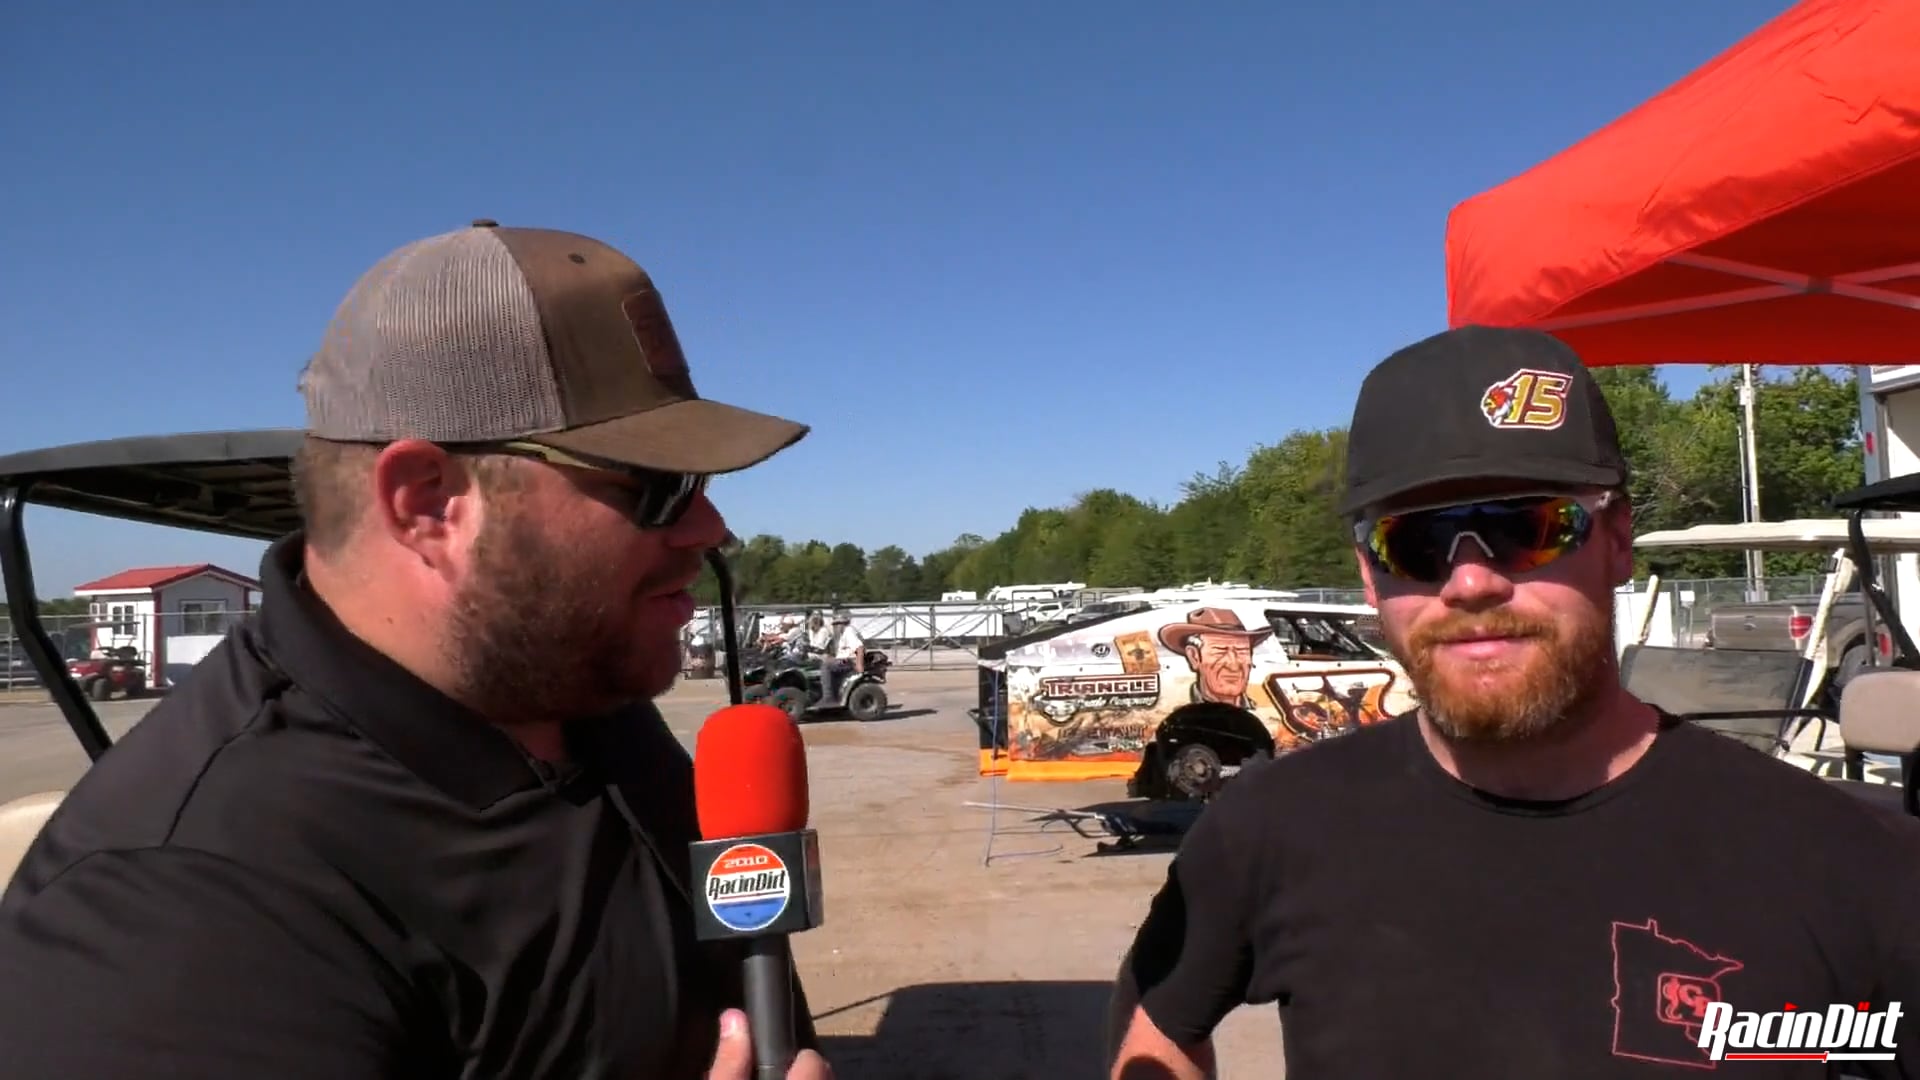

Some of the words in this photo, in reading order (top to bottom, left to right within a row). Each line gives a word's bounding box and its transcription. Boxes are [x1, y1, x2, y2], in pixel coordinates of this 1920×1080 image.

[1504, 374, 1567, 425] 15
[1046, 680, 1156, 697] TRIANGLE
[708, 870, 785, 900] RacinDirt
